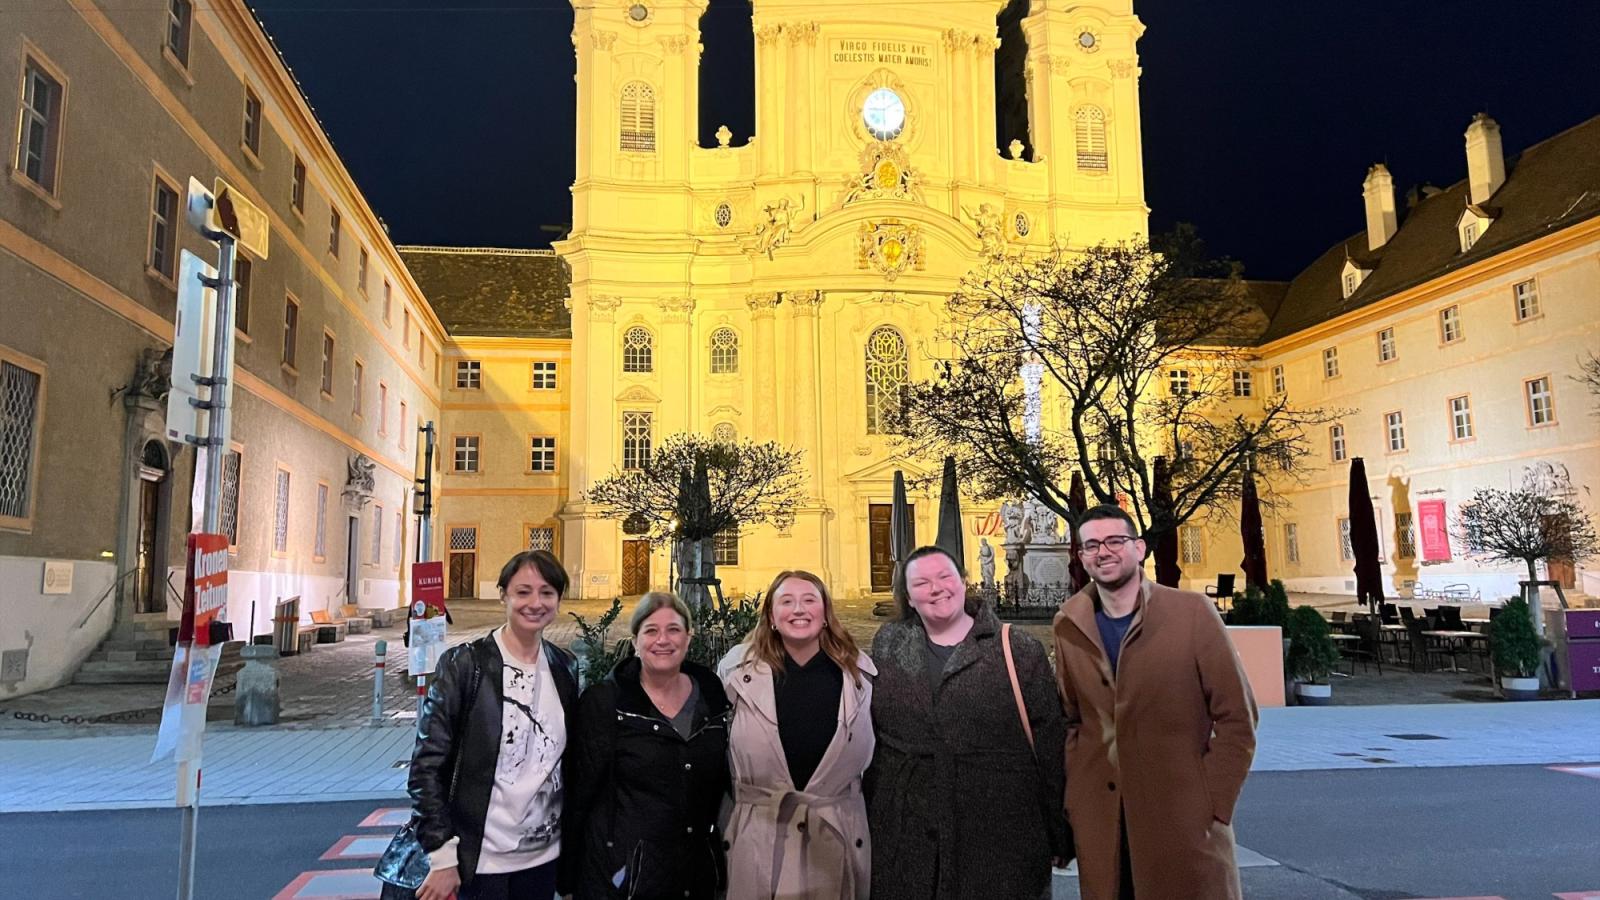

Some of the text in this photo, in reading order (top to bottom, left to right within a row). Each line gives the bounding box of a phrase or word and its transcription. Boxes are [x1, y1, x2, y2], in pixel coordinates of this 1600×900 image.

[840, 40, 927, 56] VIRGO FIDELIS AVE
[834, 53, 875, 63] COELESTIS
[878, 53, 902, 64] MATER
[194, 547, 228, 579] Kronen
[418, 576, 442, 585] KURIER
